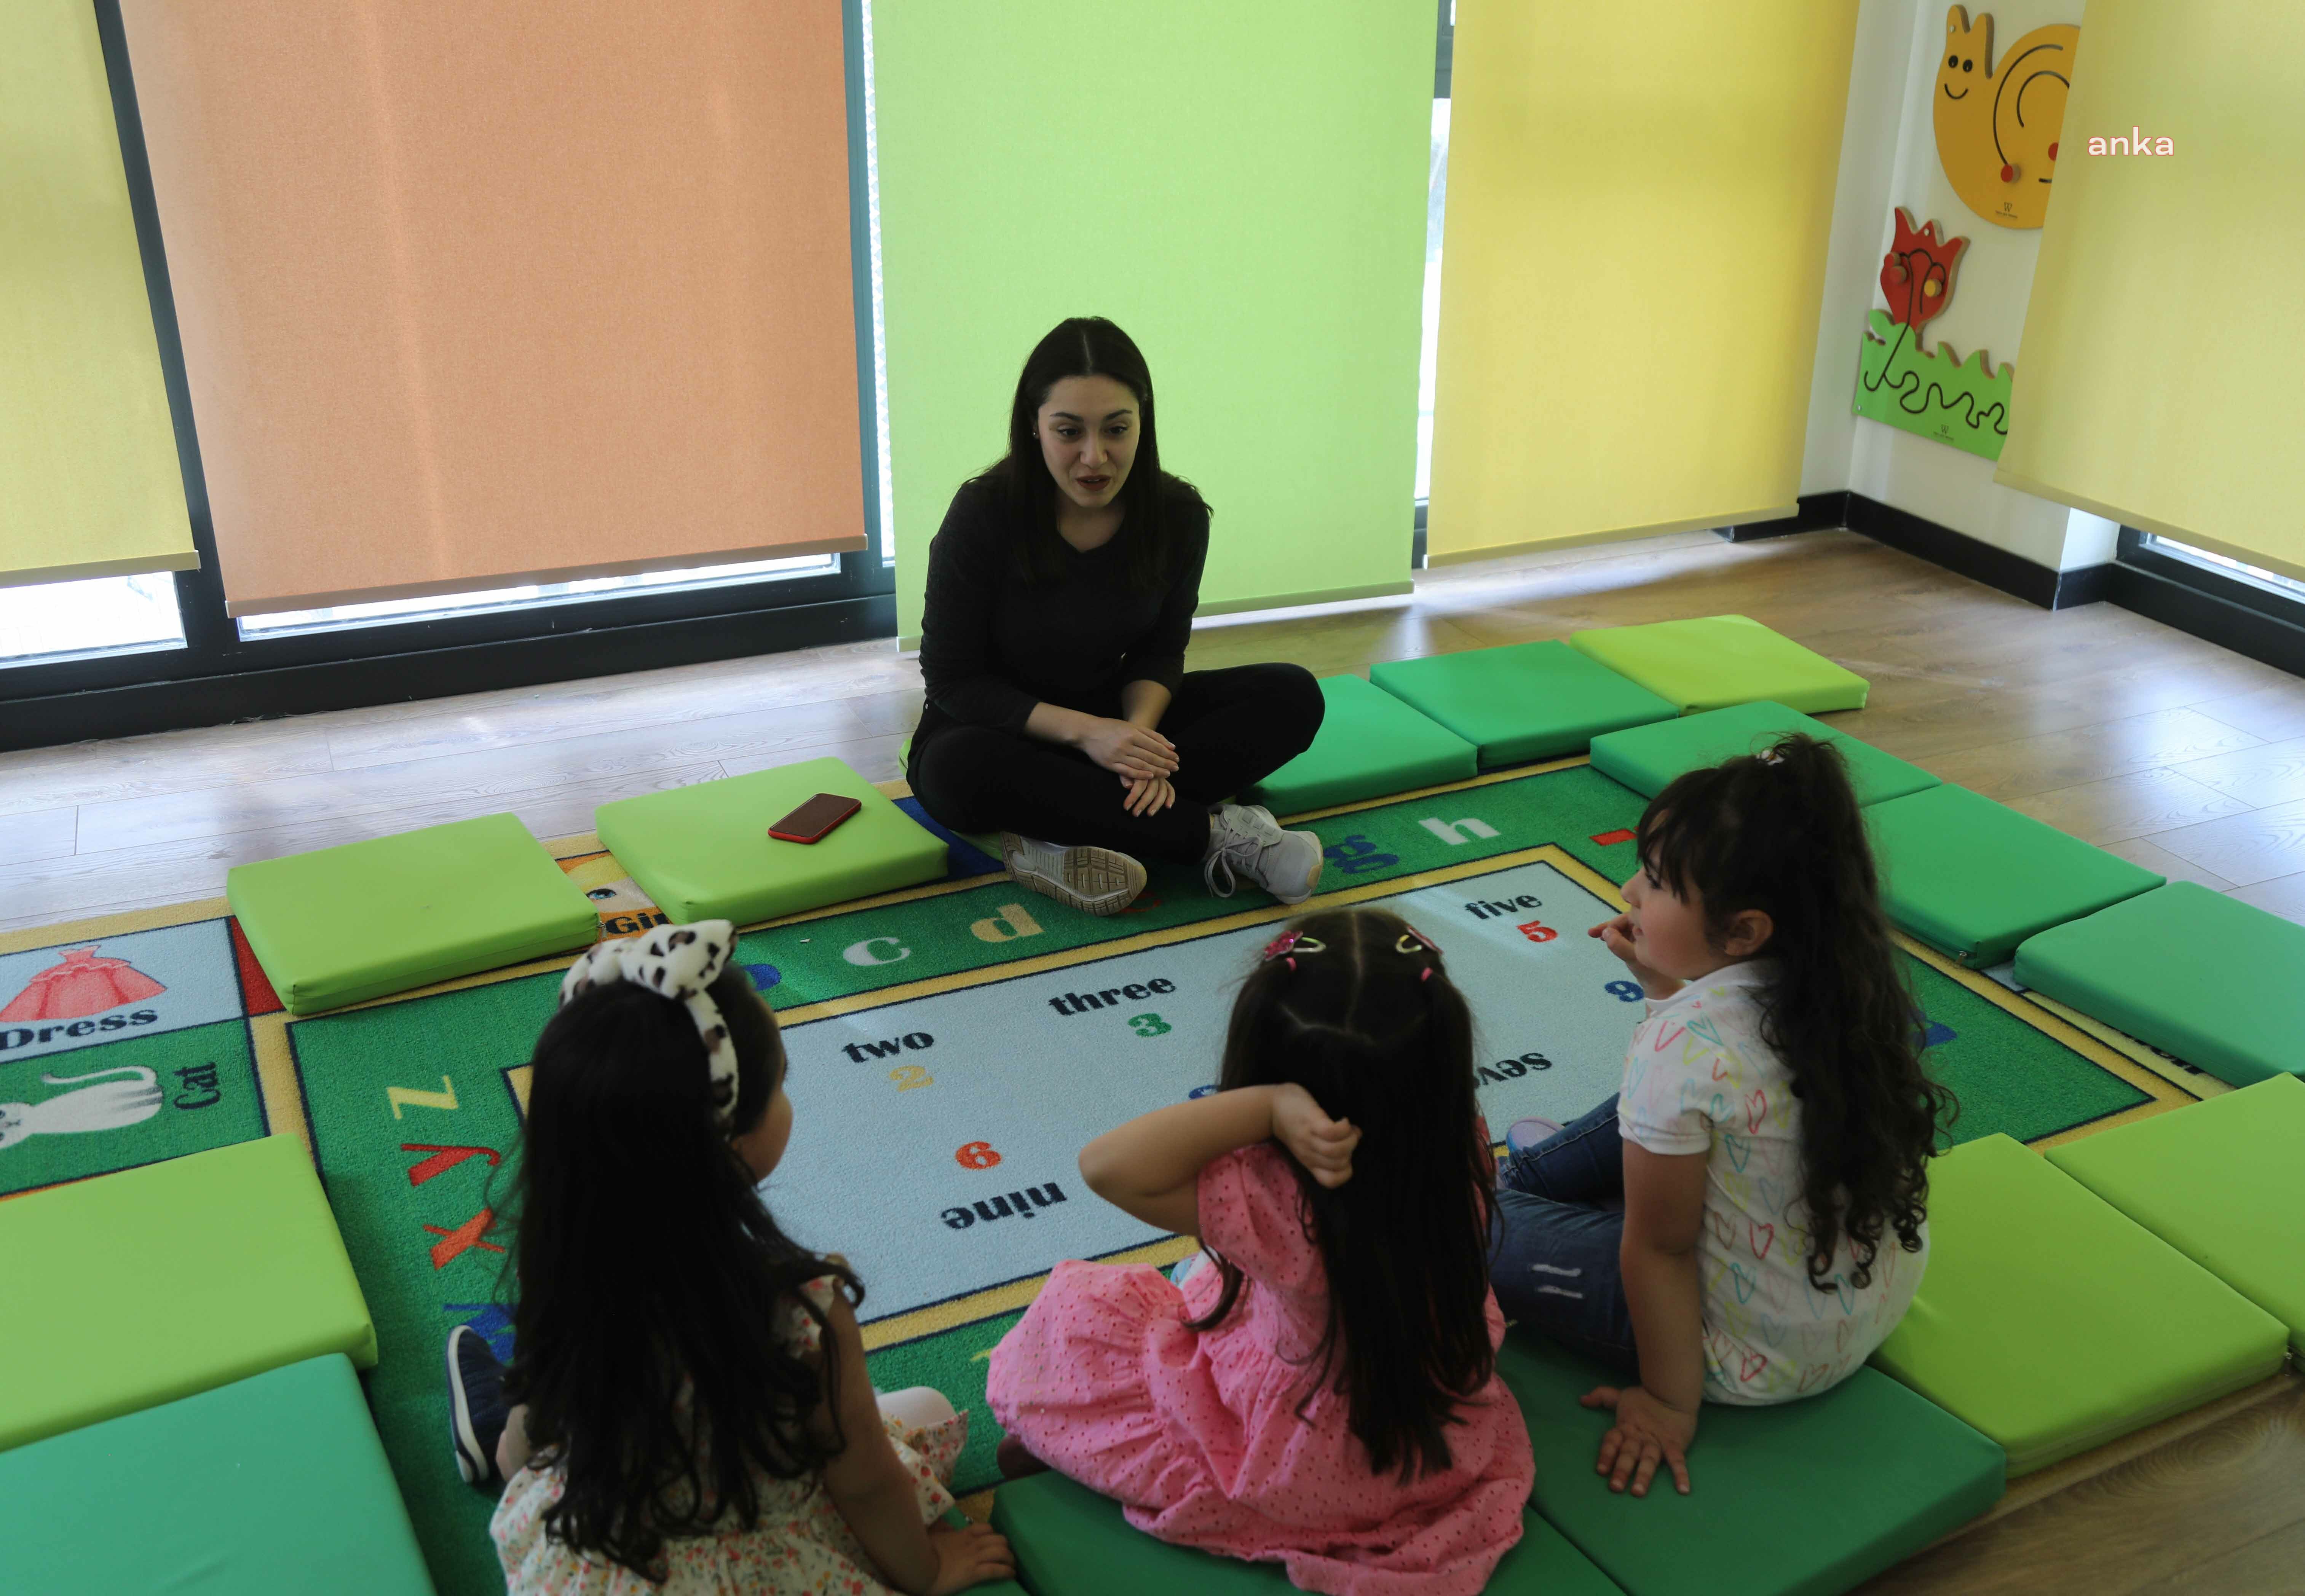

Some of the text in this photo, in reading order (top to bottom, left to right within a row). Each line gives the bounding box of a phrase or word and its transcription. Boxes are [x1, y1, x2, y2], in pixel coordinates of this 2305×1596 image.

[1418, 817, 1500, 845] h
[970, 903, 1044, 943] d
[1465, 894, 1543, 920] five
[1517, 920, 1558, 942] 5
[1049, 978, 1176, 1016] three
[0, 1009, 158, 1051] Dress
[1128, 1013, 1172, 1037] 3
[842, 1032, 934, 1063] two
[174, 1062, 221, 1110] Cat
[889, 1065, 934, 1092] 2
[1472, 1052, 1552, 1089] sev
[941, 1182, 1067, 1229] nine
